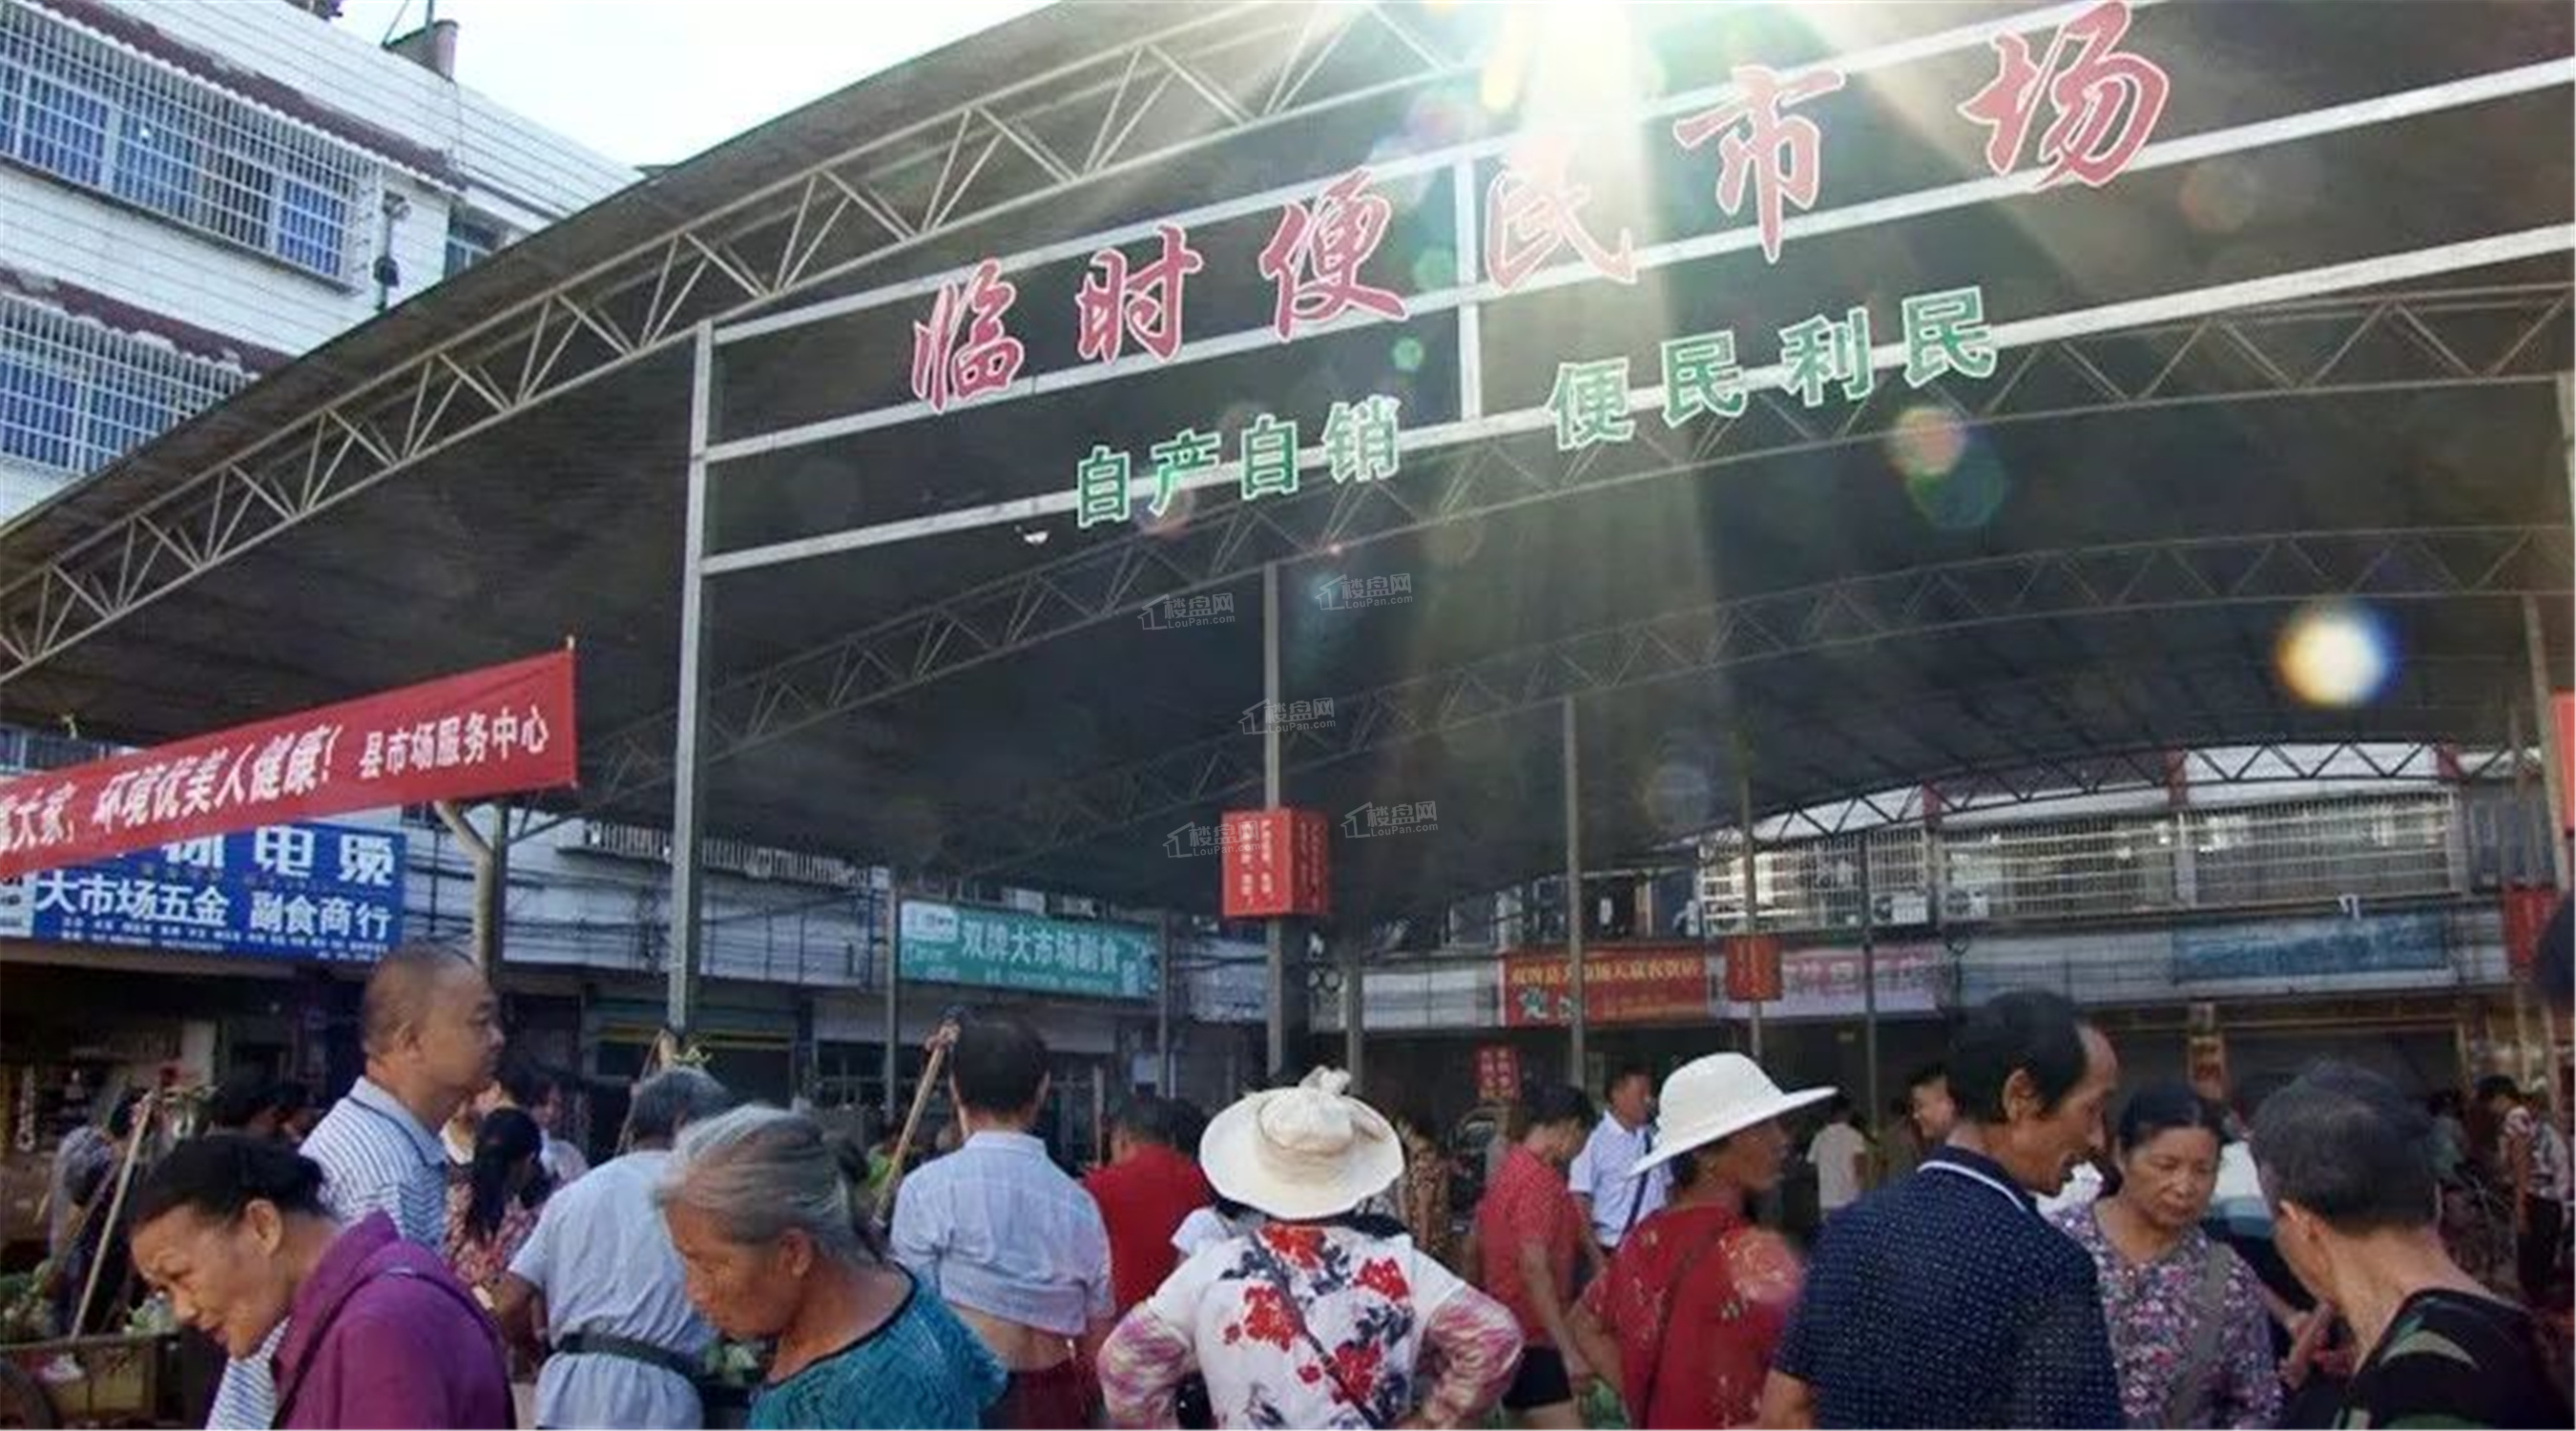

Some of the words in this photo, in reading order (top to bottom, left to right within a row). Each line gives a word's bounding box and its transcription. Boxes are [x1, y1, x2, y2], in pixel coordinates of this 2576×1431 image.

[912, 0, 2169, 414] 临时便民市场
[1077, 395, 1401, 529] 自产自销
[1545, 286, 1997, 450] 便民利民
[359, 705, 549, 778] 县市场服务中心
[35, 869, 230, 926] 大市场五金
[250, 890, 392, 940] 副食商行
